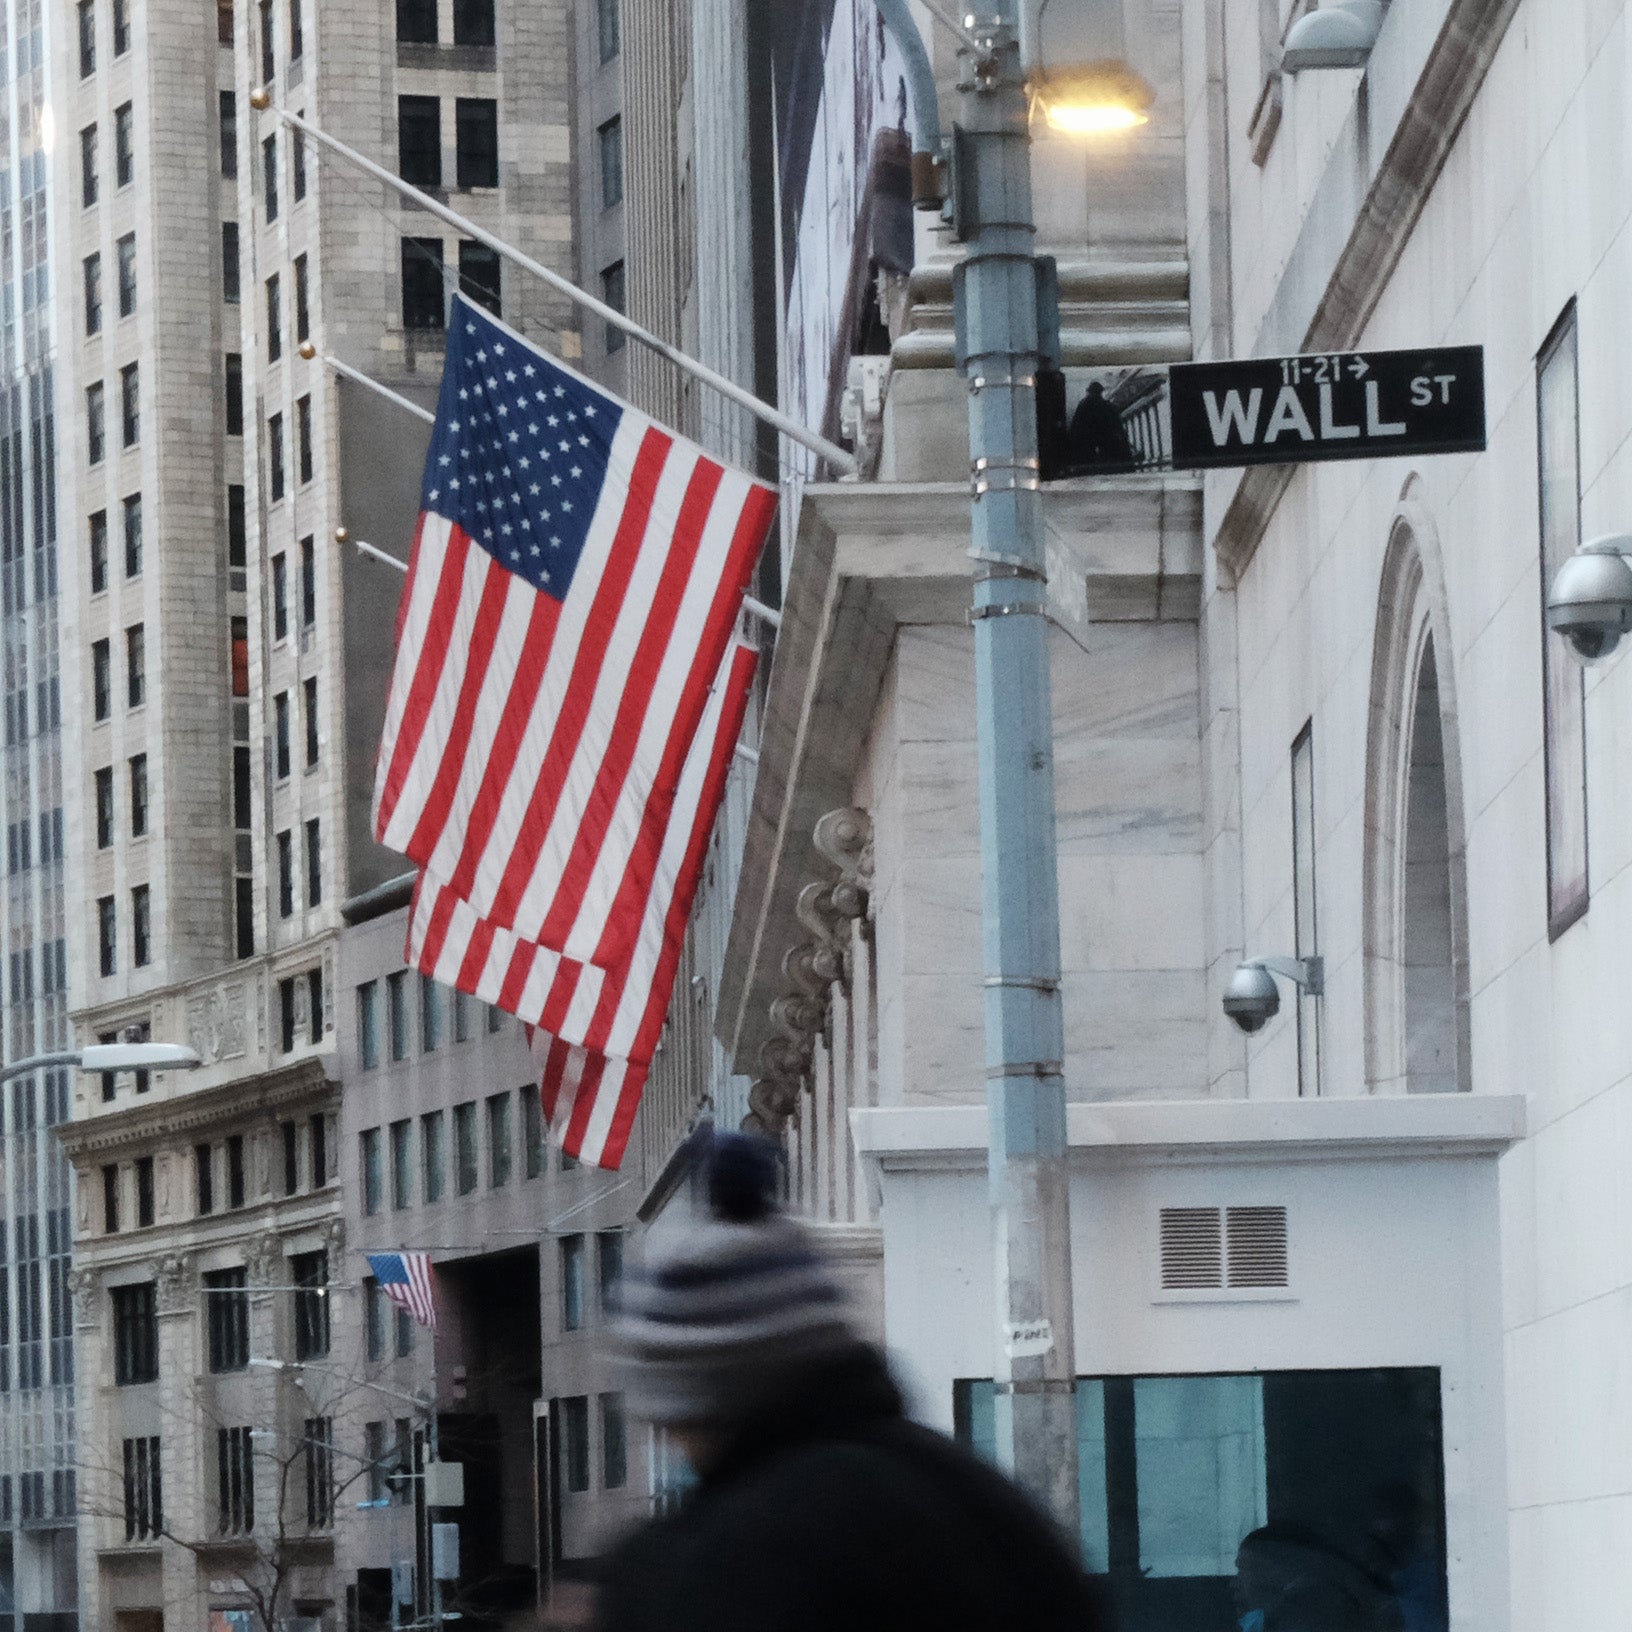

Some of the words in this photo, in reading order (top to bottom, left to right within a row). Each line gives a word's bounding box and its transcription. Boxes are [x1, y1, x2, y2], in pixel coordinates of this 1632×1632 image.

[1280, 355, 1342, 385] 11-21
[1201, 380, 1407, 447] WALL
[1409, 374, 1457, 407] ST
